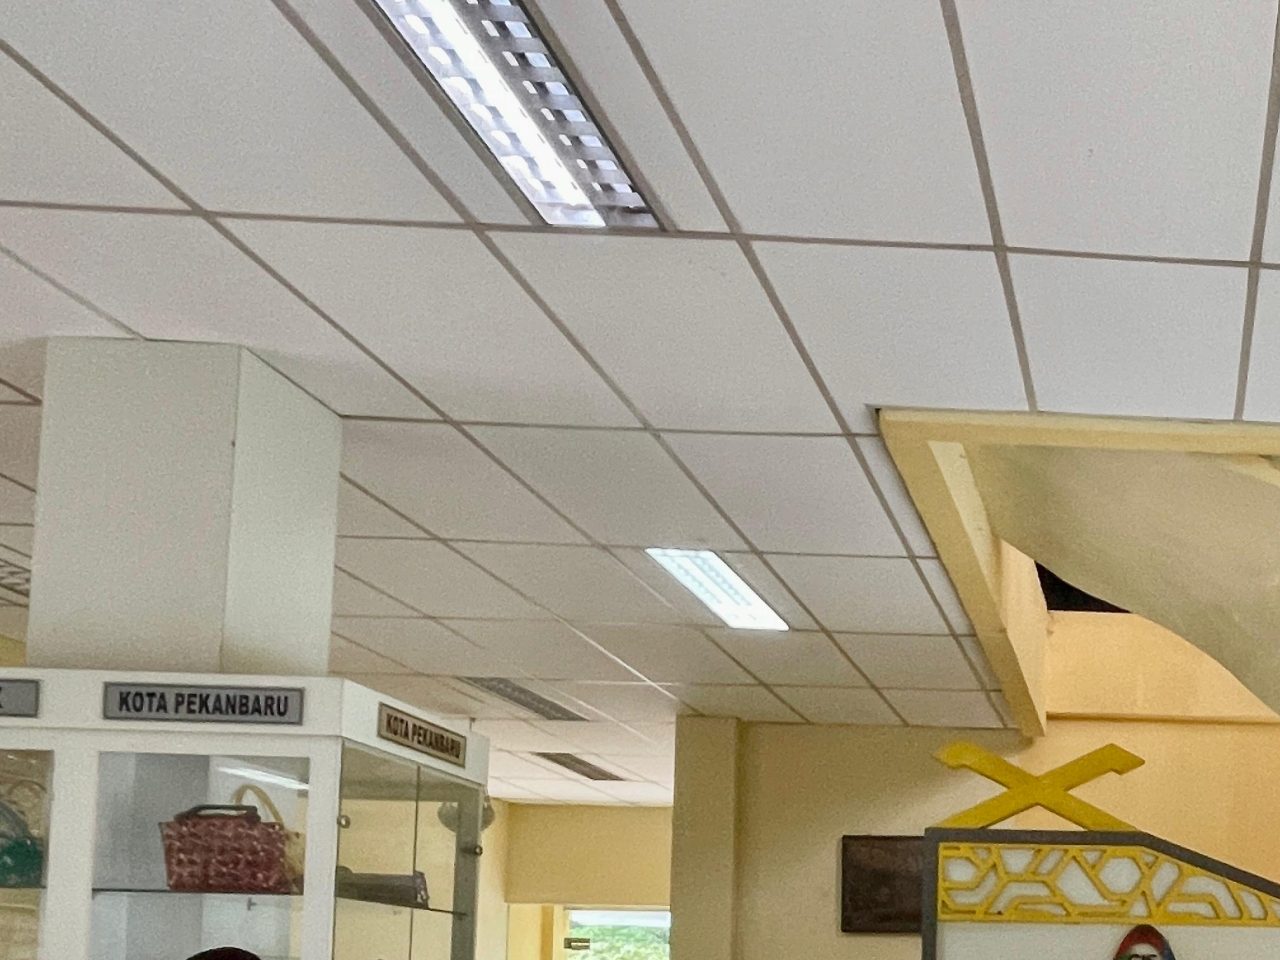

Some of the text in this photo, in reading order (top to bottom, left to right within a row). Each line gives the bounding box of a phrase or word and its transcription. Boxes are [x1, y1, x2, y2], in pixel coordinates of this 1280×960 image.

[119, 691, 289, 717] KOTA PEKANBARU
[386, 713, 461, 759] KOTA PEKANBARU
